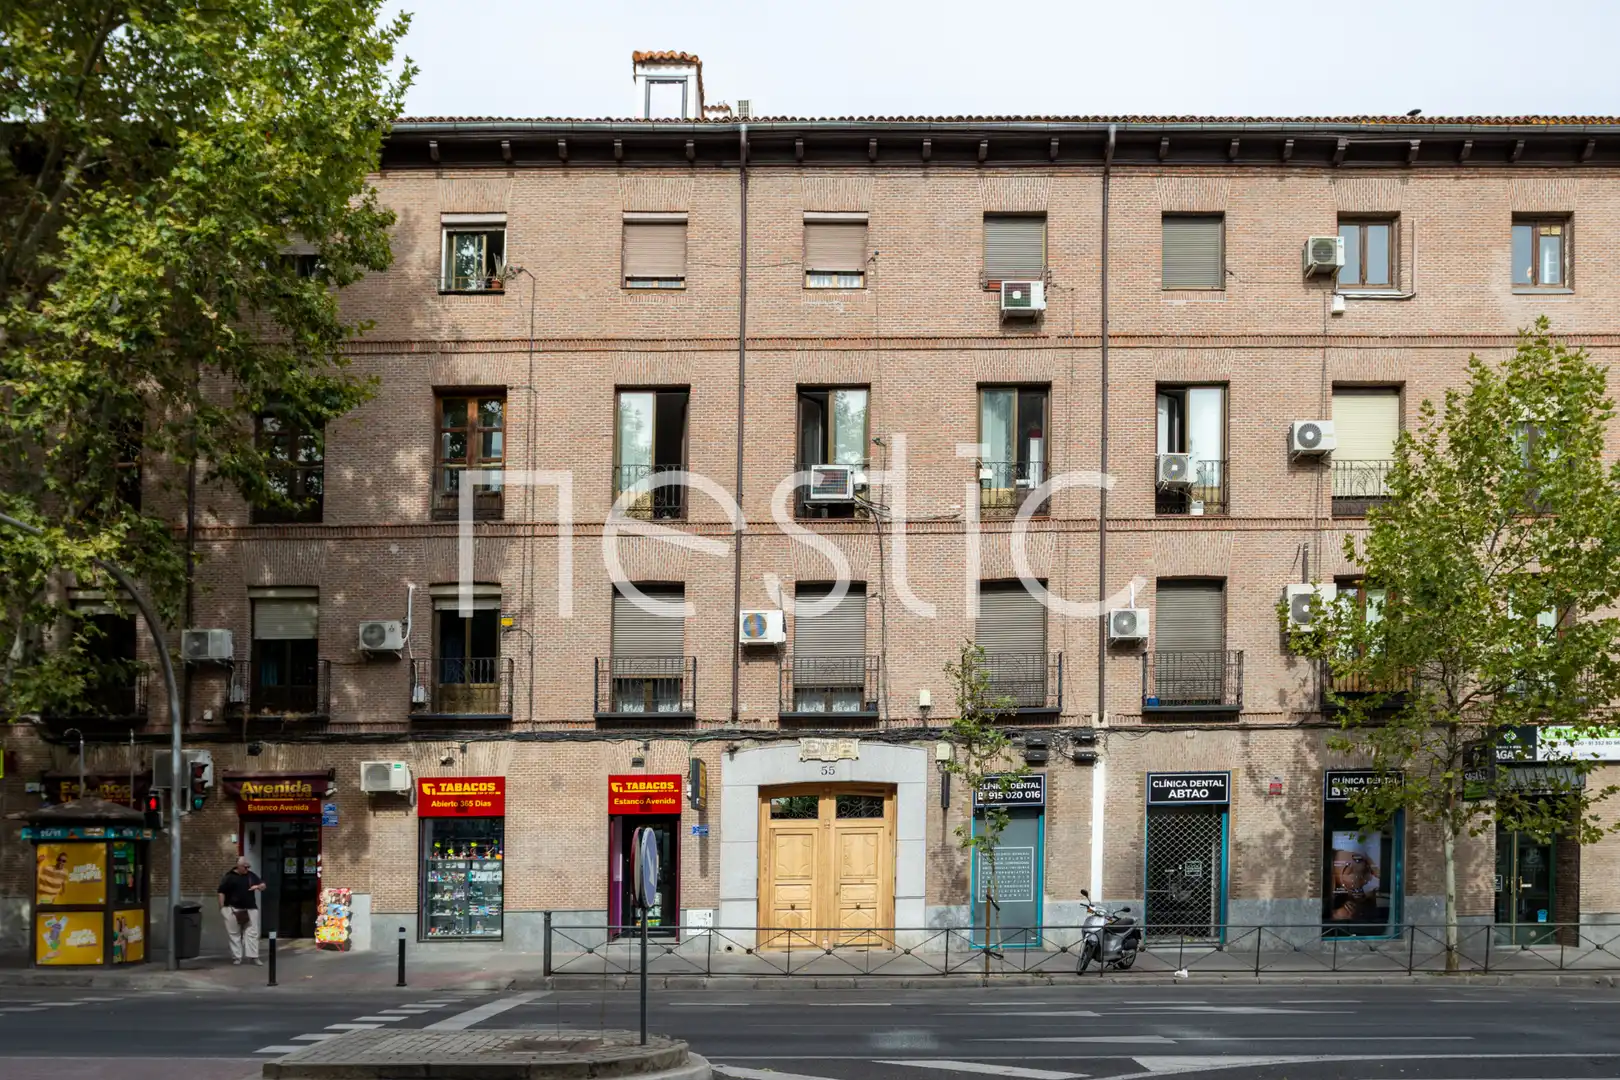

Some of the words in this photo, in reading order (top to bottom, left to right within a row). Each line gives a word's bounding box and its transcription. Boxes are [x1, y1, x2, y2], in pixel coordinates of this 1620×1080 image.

[821, 765, 836, 776] 55
[241, 780, 313, 795] Avenida
[439, 782, 497, 792] TABACOS
[625, 781, 675, 790] TABACOS
[1152, 779, 1188, 788] CLÍNICA
[1189, 779, 1225, 788] DENTAL
[988, 791, 1004, 800] 915
[1005, 791, 1023, 799] 020
[1024, 790, 1041, 799] 016
[1168, 789, 1209, 799] ABTAO
[431, 800, 459, 808] Abierto
[459, 800, 474, 808] 365
[645, 797, 676, 805] Avenida
[247, 804, 278, 812] Estanco
[279, 803, 309, 812] Avenida
